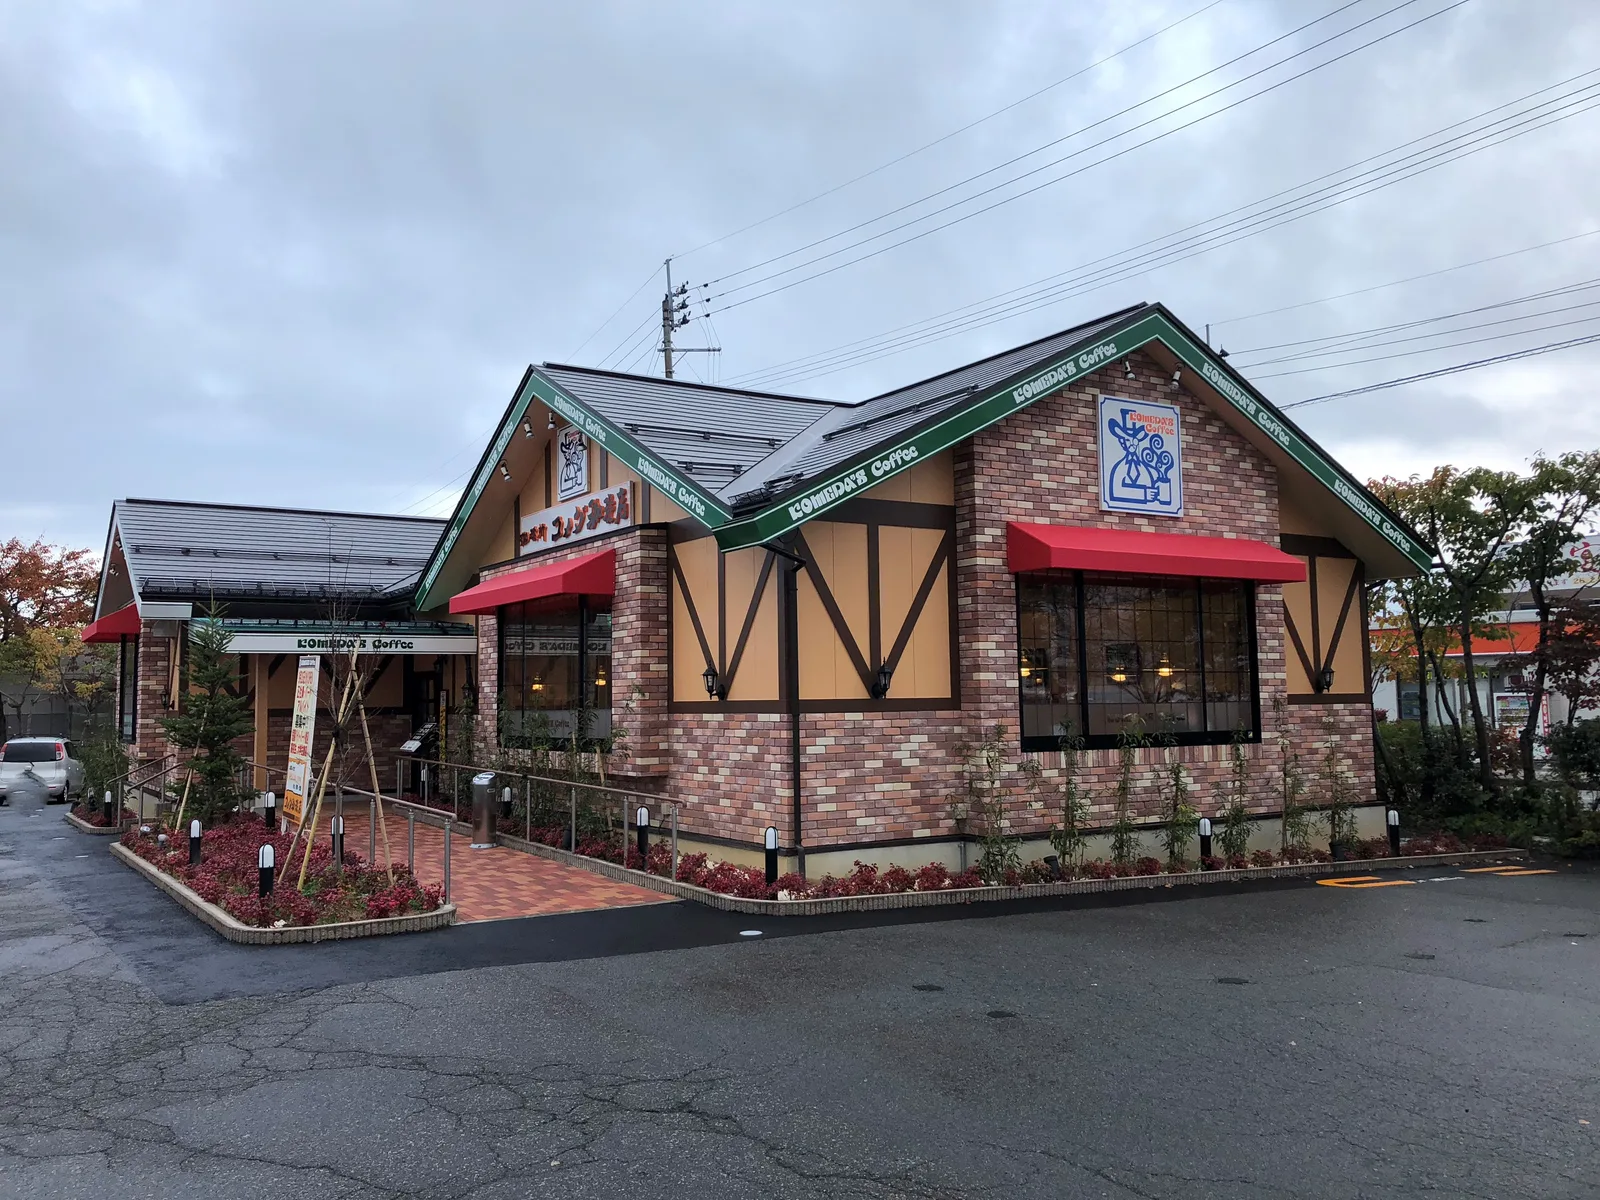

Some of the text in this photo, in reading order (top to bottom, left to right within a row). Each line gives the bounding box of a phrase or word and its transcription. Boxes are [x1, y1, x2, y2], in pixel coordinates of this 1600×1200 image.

[1012, 342, 1118, 406] KOMEDA'S Coffee
[585, 418, 607, 443] Coffee
[1129, 412, 1174, 426] KOMEDA'S
[1145, 423, 1175, 436] Coffee
[1202, 362, 1291, 448] KOMEDA'S Coffee
[637, 456, 706, 517] KOMEDA'S Coffee
[787, 444, 919, 522] KOMEDA'S Coffee
[1333, 478, 1411, 553] KOMEDA'S Coffee
[372, 639, 414, 650] Coffee
